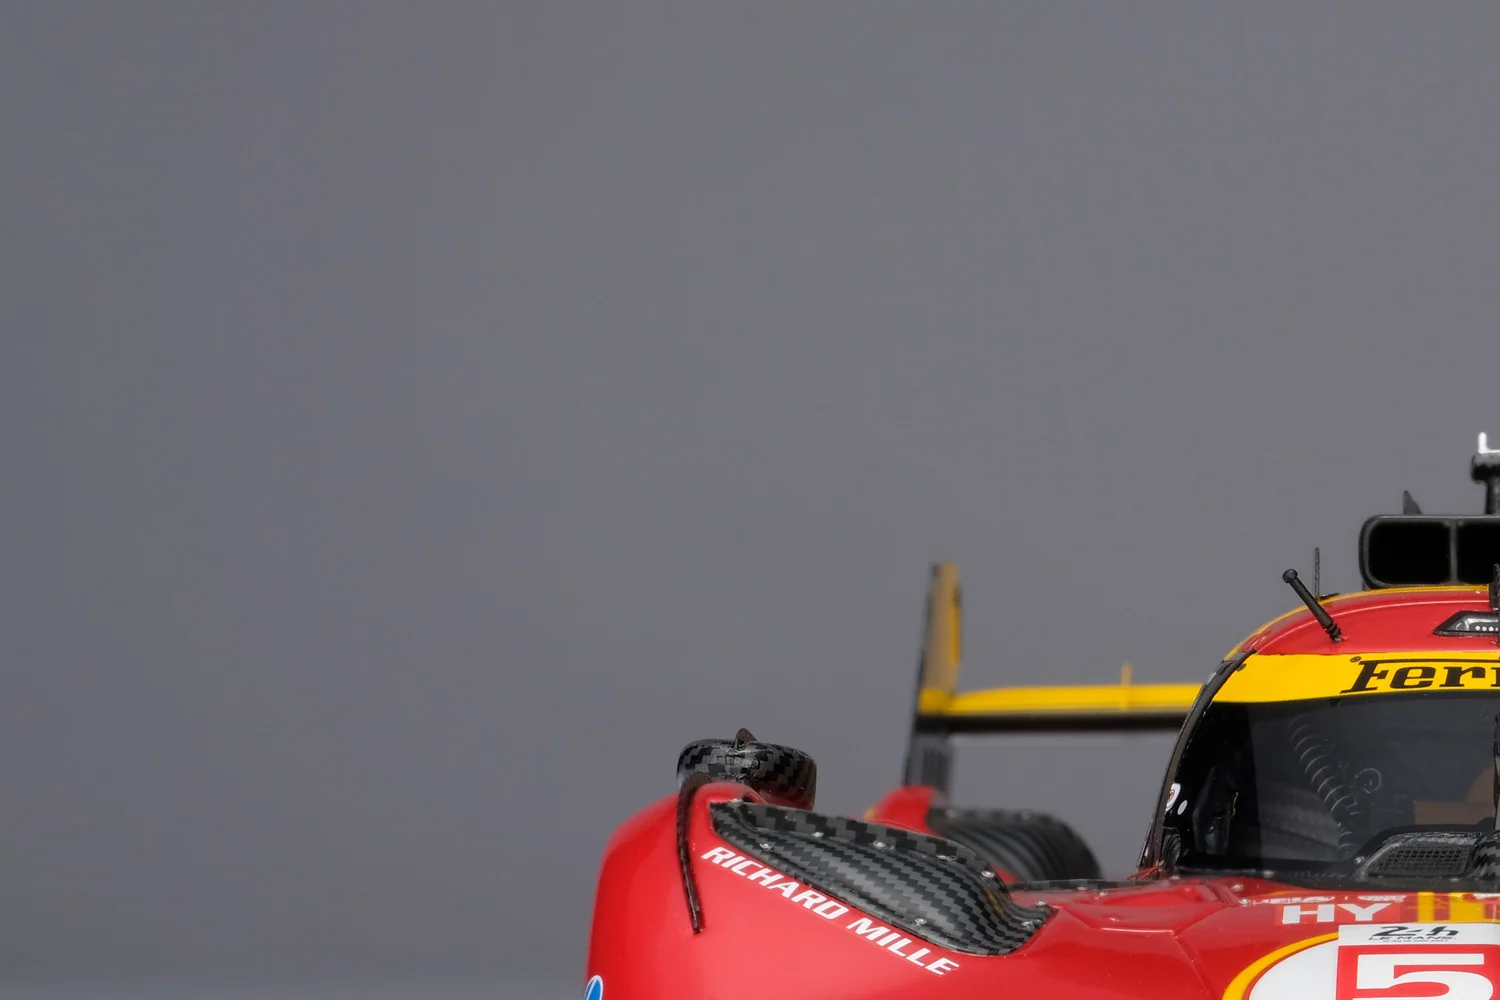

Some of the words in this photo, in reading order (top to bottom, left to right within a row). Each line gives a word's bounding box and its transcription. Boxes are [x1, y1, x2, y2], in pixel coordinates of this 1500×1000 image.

[701, 846, 849, 920] RICHARD
[845, 916, 960, 975] MILLE
[1282, 903, 1392, 924] HY
